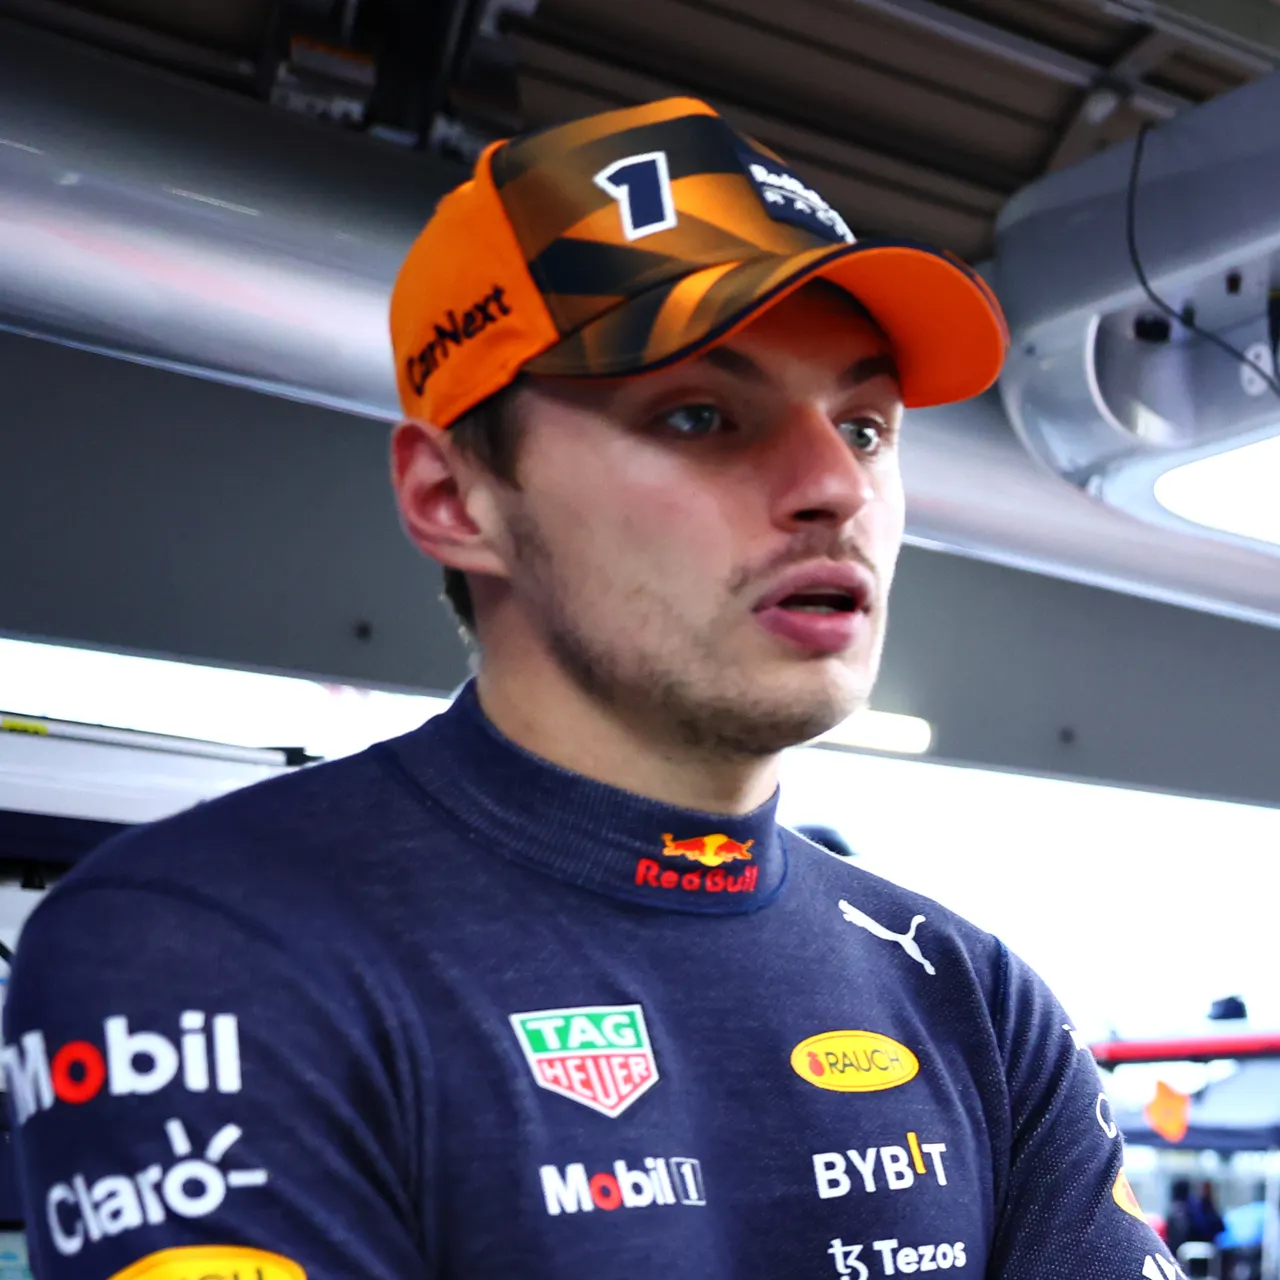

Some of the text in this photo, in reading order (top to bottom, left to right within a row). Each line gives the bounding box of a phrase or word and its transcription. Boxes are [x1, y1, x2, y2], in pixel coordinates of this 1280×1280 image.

[593, 151, 678, 241] 1
[406, 284, 511, 397] CarNext
[634, 858, 759, 893] Red Bull
[525, 1014, 638, 1050] TAG
[825, 1049, 903, 1075] RAUCH
[1, 1009, 243, 1125] Mobil
[540, 1055, 650, 1106] HEUER
[46, 1132, 250, 1256] Claro
[538, 1157, 677, 1217] Mobil
[812, 1132, 948, 1199] BYBIT
[872, 1238, 967, 1276] Tezos
